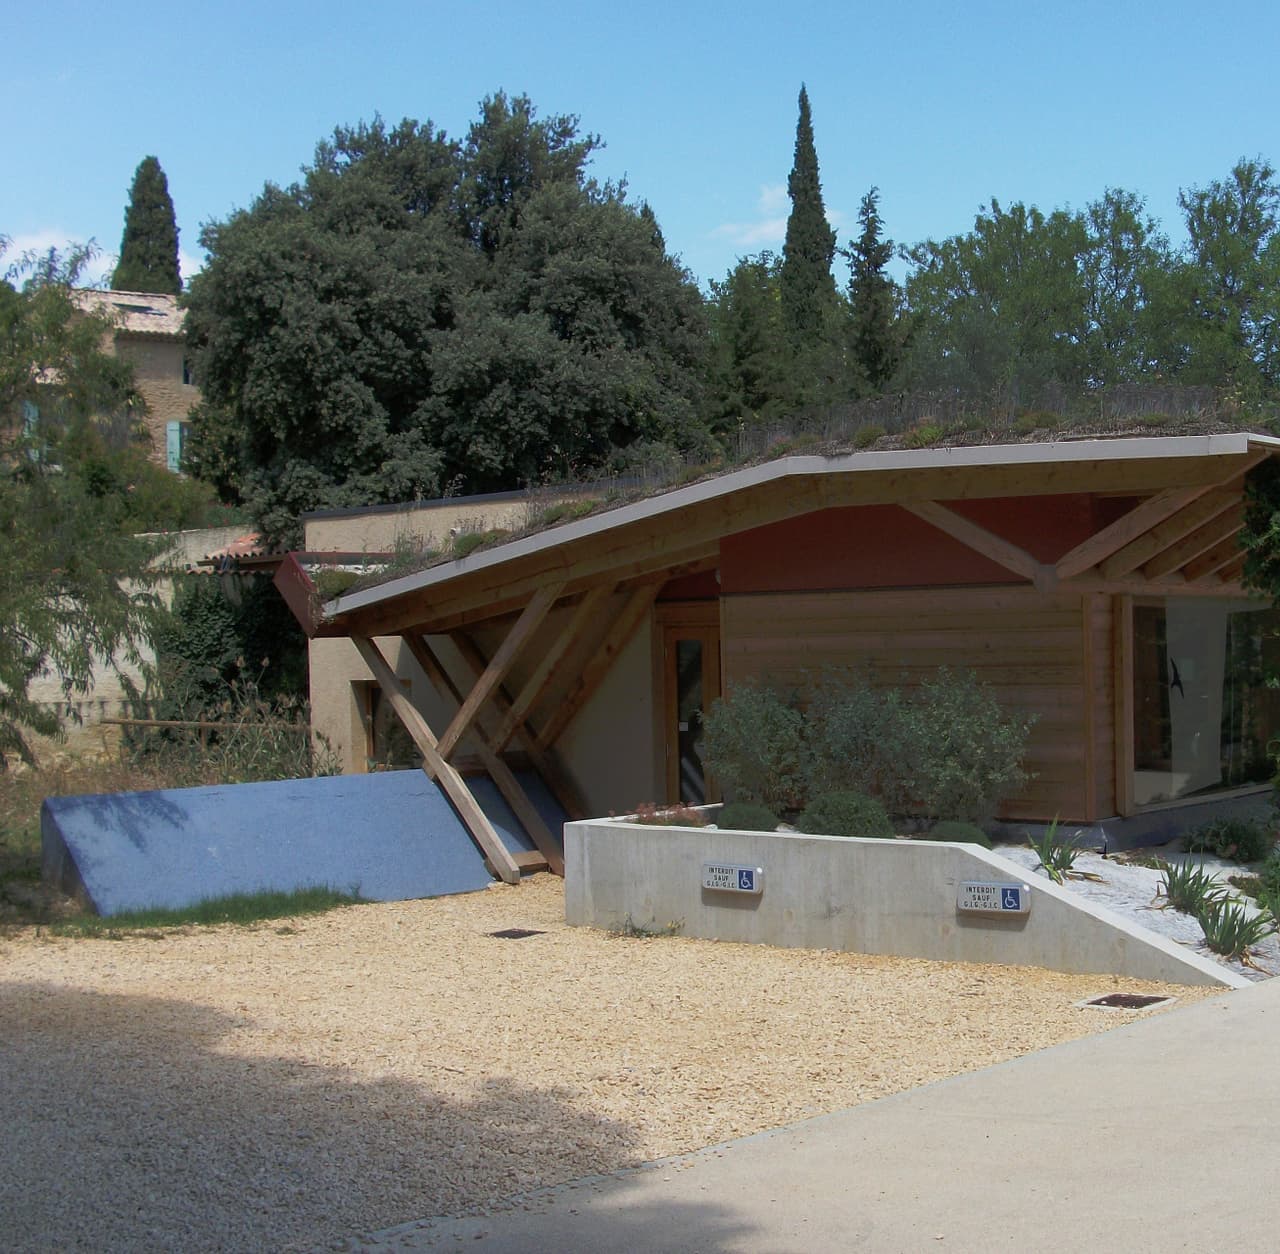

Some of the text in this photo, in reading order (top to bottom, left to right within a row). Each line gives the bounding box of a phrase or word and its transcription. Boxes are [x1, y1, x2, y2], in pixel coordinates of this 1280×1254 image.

[708, 867, 734, 875] INTERDIT
[966, 886, 996, 894] INTERDIT
[972, 894, 991, 902] SAUF
